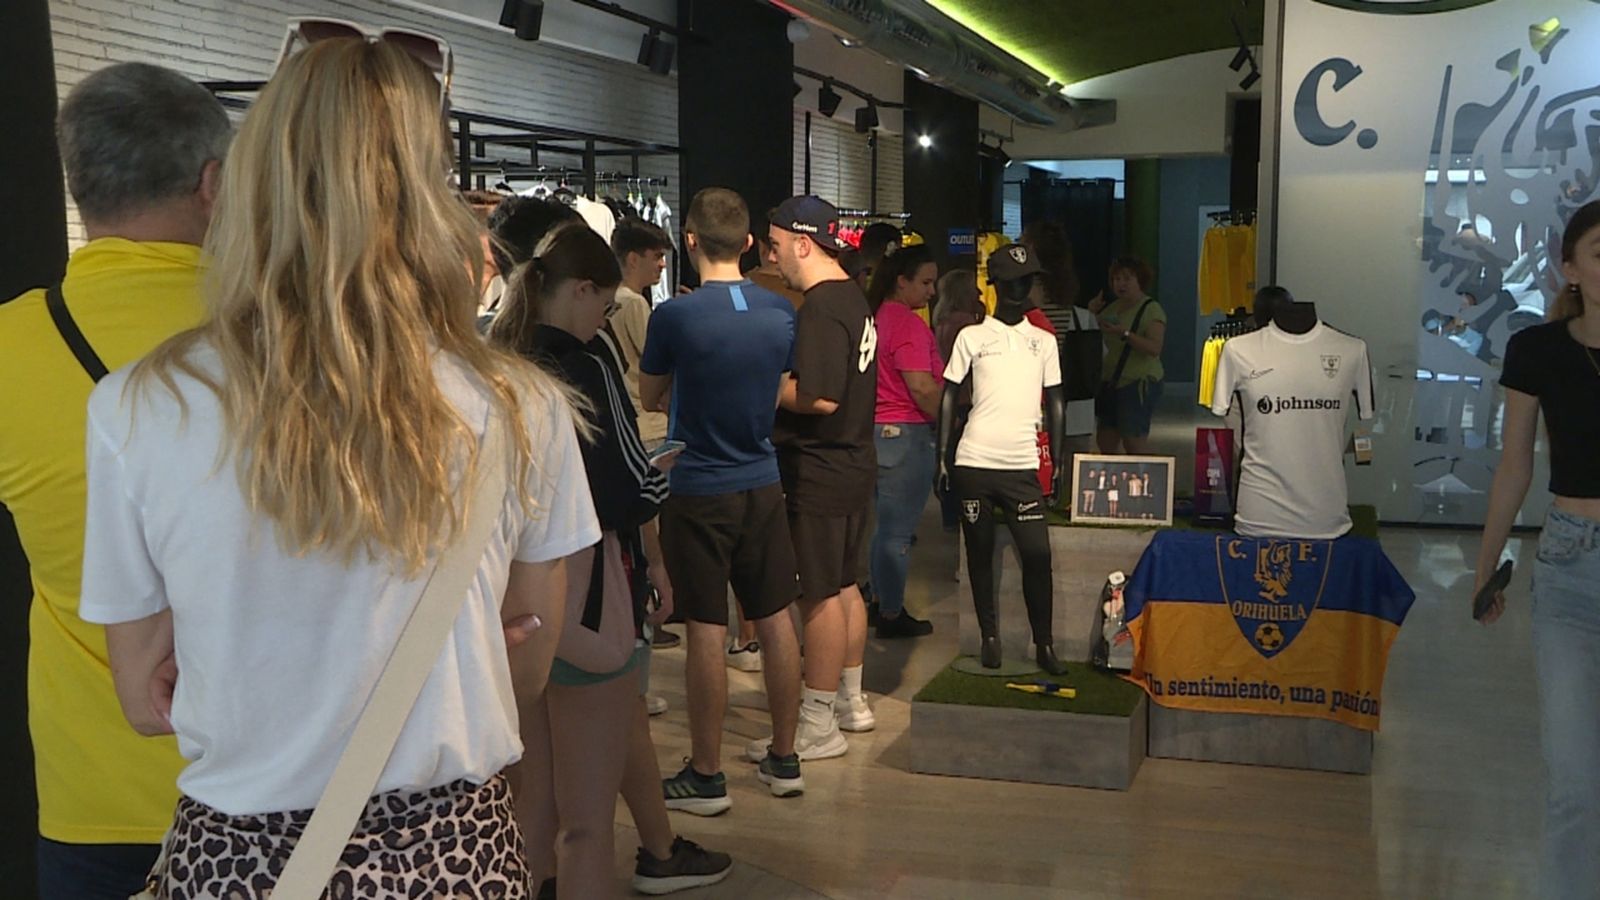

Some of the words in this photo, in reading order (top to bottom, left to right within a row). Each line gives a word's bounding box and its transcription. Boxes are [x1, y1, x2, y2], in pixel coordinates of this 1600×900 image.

[1294, 57, 1378, 149] C.
[950, 234, 975, 245] OUTLE
[1274, 396, 1341, 414] johnson
[1228, 540, 1247, 559] C.
[1299, 543, 1317, 561] F.
[1232, 600, 1308, 621] ORIHUELA
[1168, 675, 1285, 705] sentimiento,
[1290, 685, 1327, 704] una
